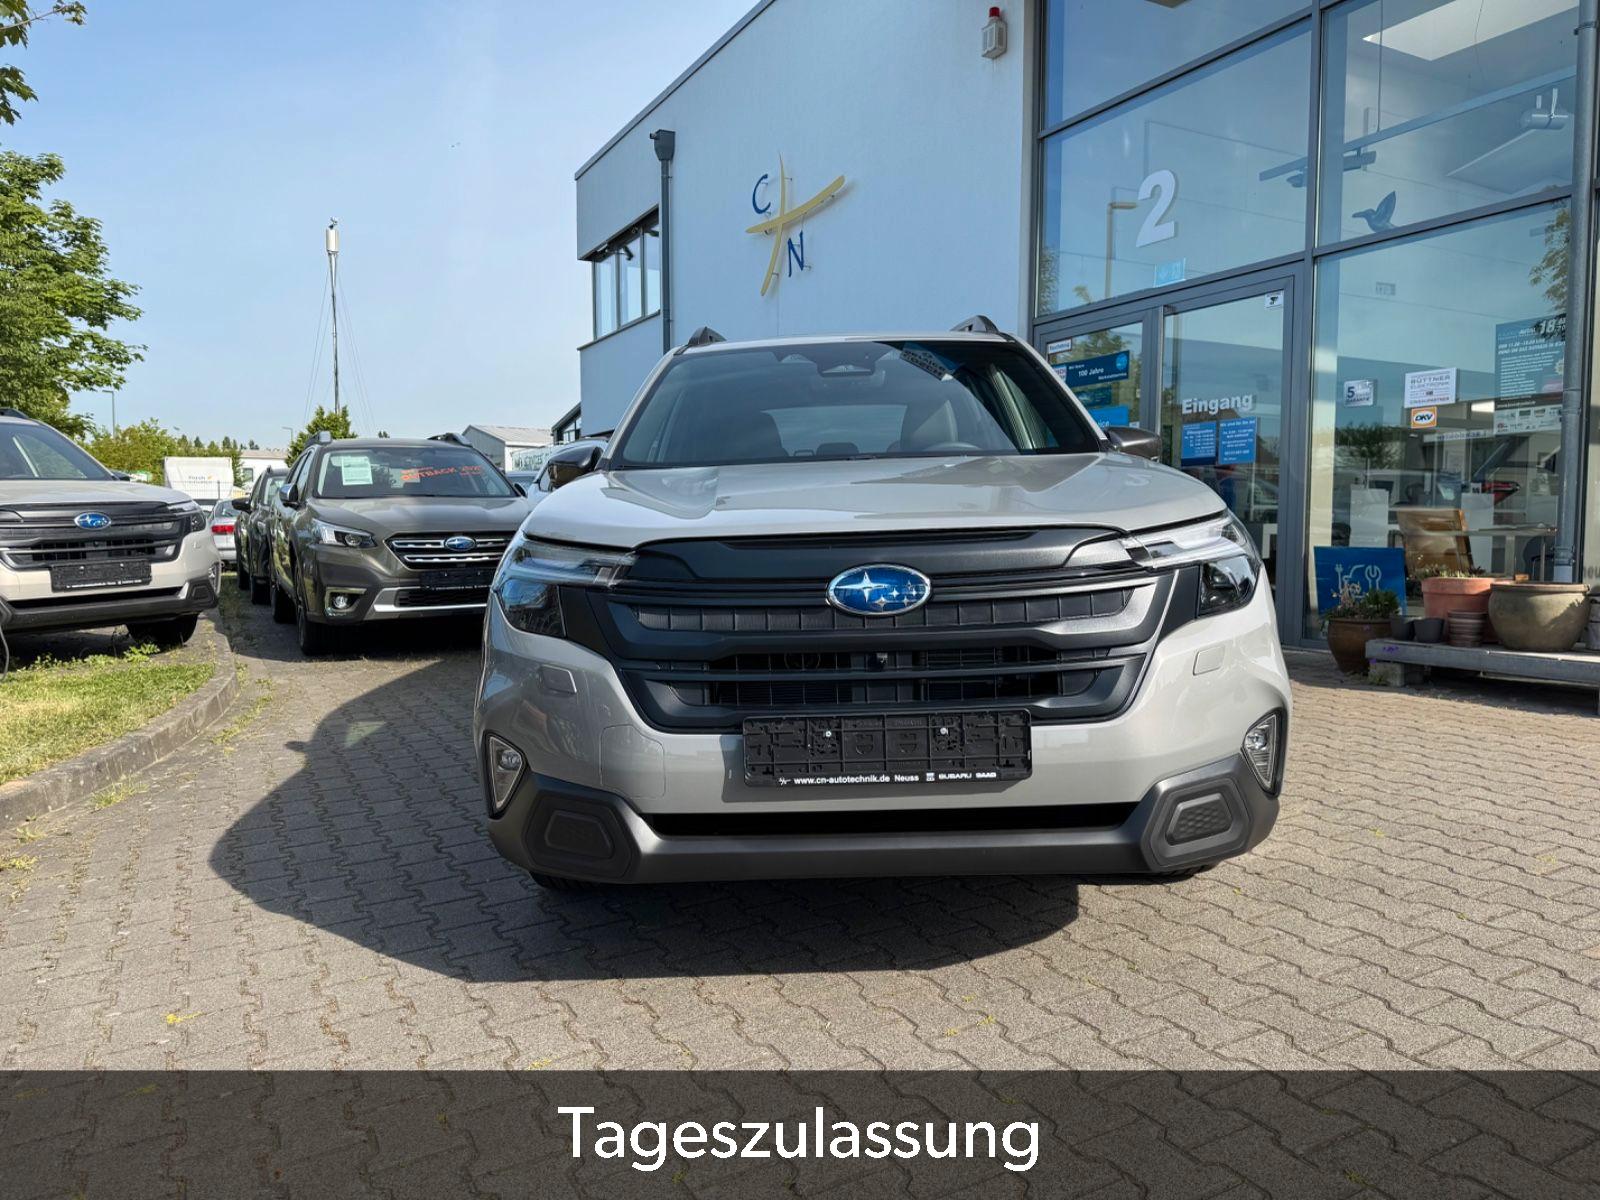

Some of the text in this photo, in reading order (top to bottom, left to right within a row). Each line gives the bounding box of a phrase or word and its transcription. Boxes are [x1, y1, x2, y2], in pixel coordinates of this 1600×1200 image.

[752, 173, 771, 214] C
[1136, 169, 1176, 248] 2
[787, 230, 804, 277] N
[1089, 367, 1105, 376] Jahre
[1347, 386, 1356, 398] 5
[1181, 394, 1253, 415] Eingang
[1414, 413, 1434, 422] DKV
[793, 773, 890, 785] www.cn-autotechnik.de
[894, 774, 920, 783] Neuss
[938, 772, 973, 781] SUBARU
